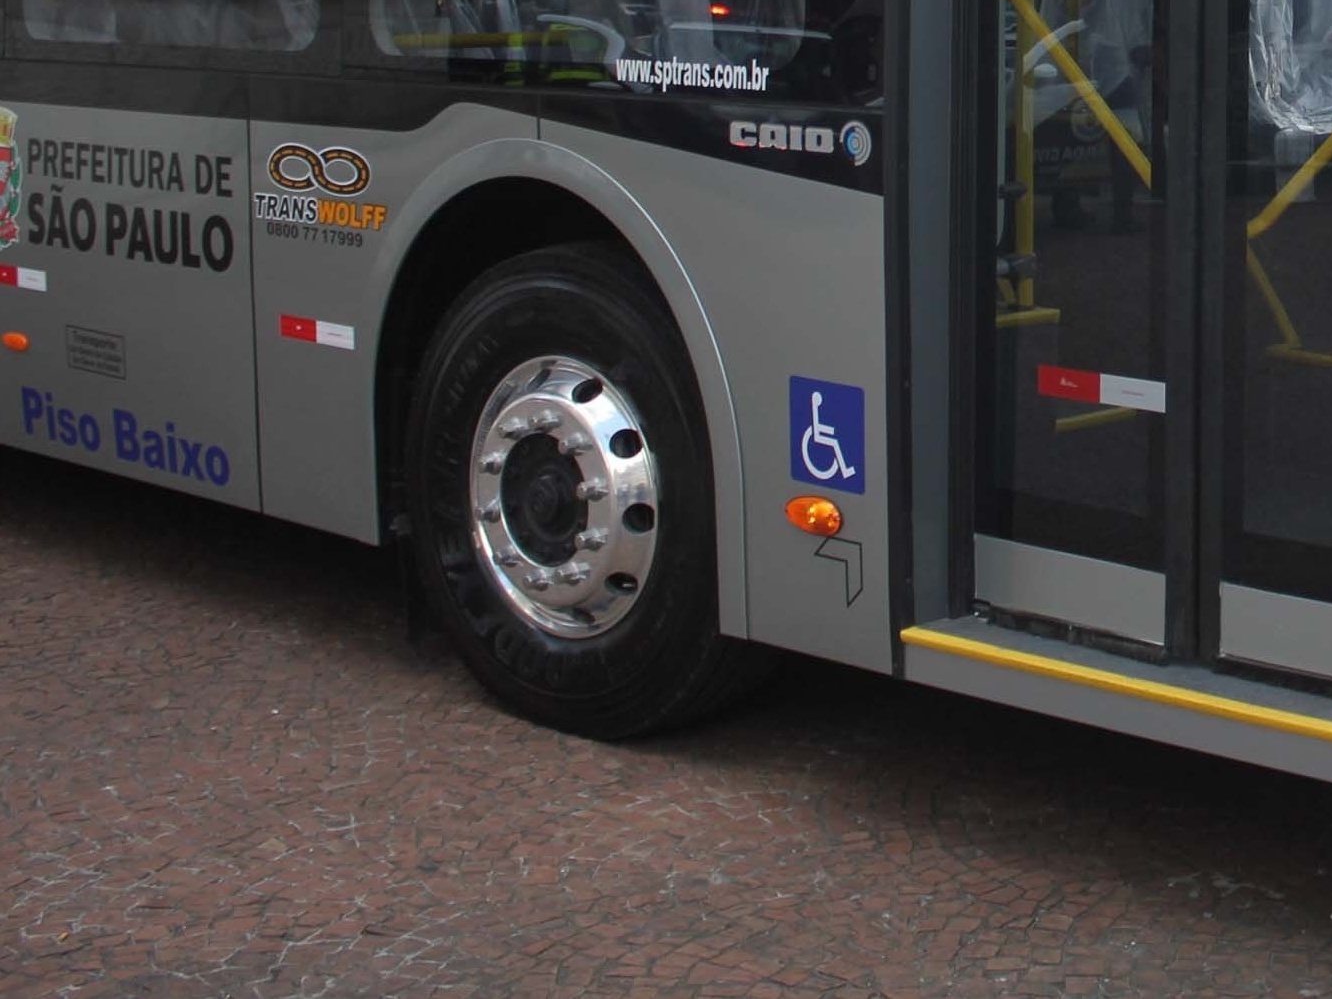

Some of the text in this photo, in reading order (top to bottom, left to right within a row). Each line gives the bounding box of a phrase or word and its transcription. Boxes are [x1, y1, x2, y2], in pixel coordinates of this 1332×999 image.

[616, 56, 769, 93] www.sptrans.com.br
[729, 121, 834, 153] CAIO
[27, 138, 233, 197] PREFEITURA DE
[28, 185, 234, 272] SÃO PAULO
[254, 193, 387, 230] TRANSWOLFF
[267, 222, 299, 239] 0800
[21, 386, 230, 486] Piso Baixo
